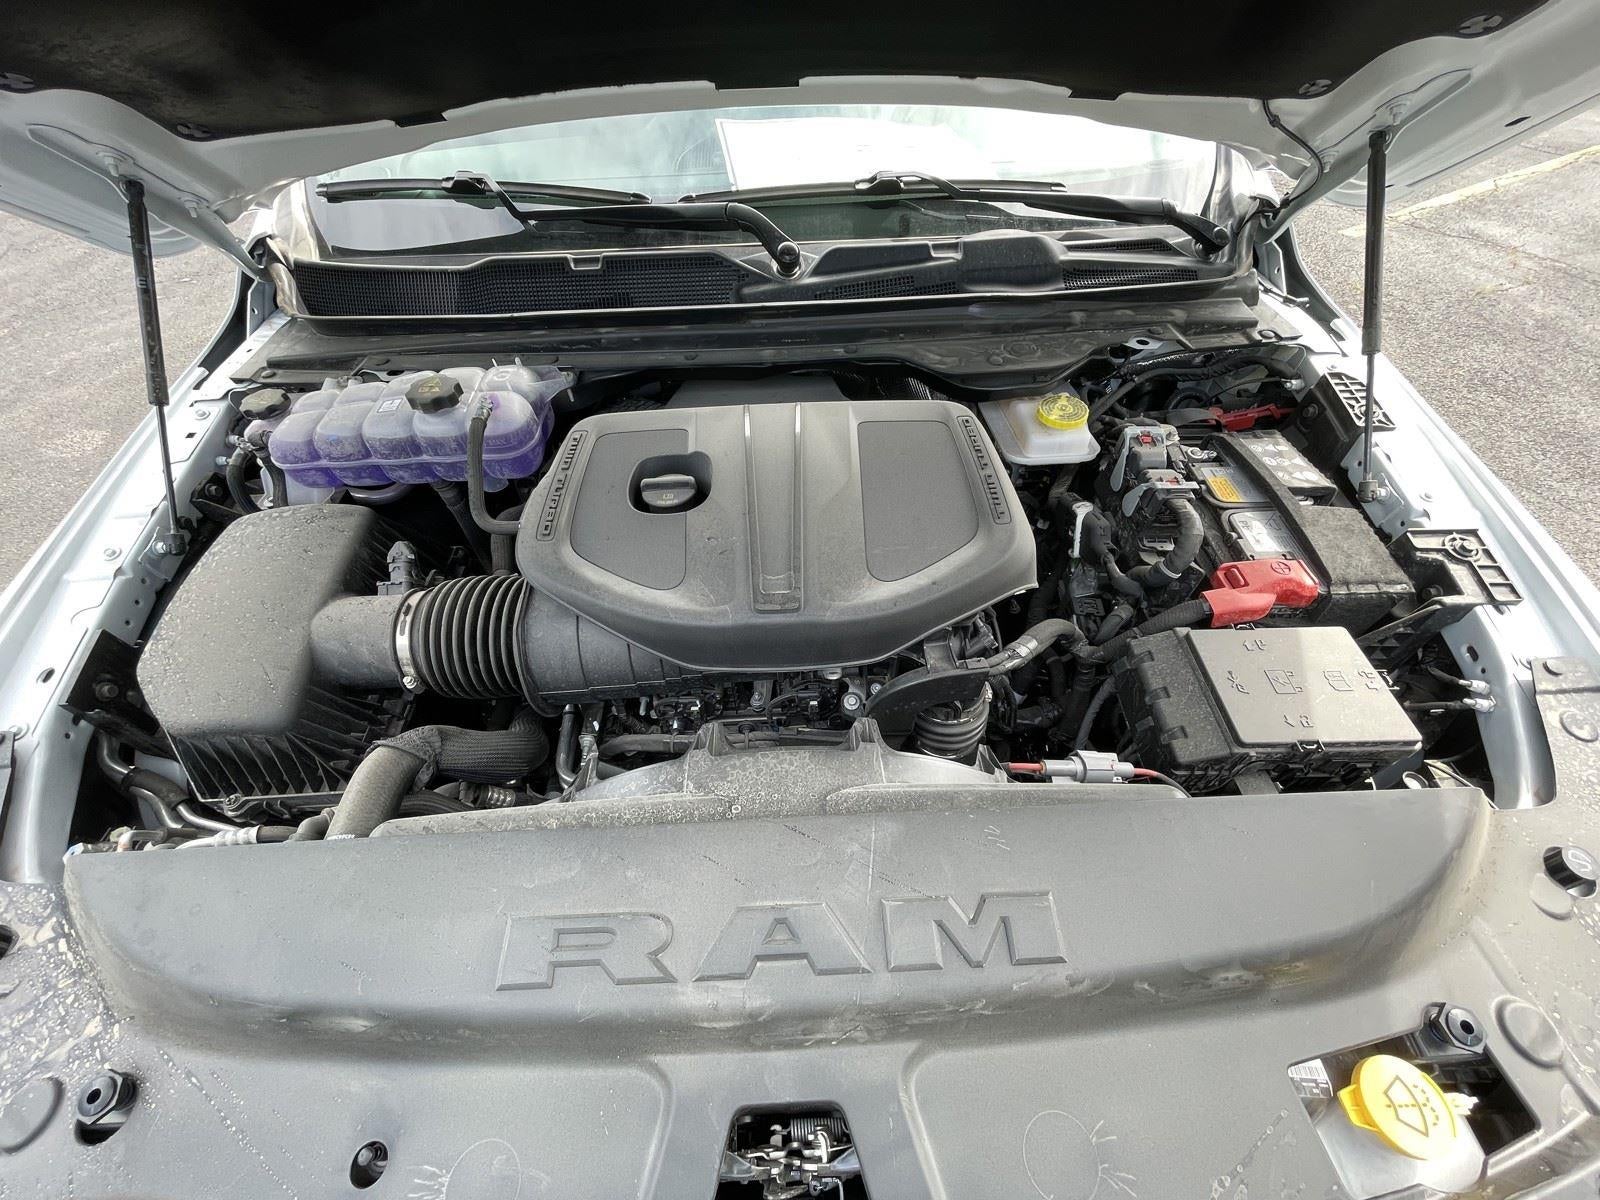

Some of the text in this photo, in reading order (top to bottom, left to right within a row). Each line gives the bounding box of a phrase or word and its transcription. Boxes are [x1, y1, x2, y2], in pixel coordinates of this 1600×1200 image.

[542, 432, 583, 537] TWIN TURBO
[961, 418, 1005, 520] TWIN TURBO
[495, 890, 1068, 992] RAM
